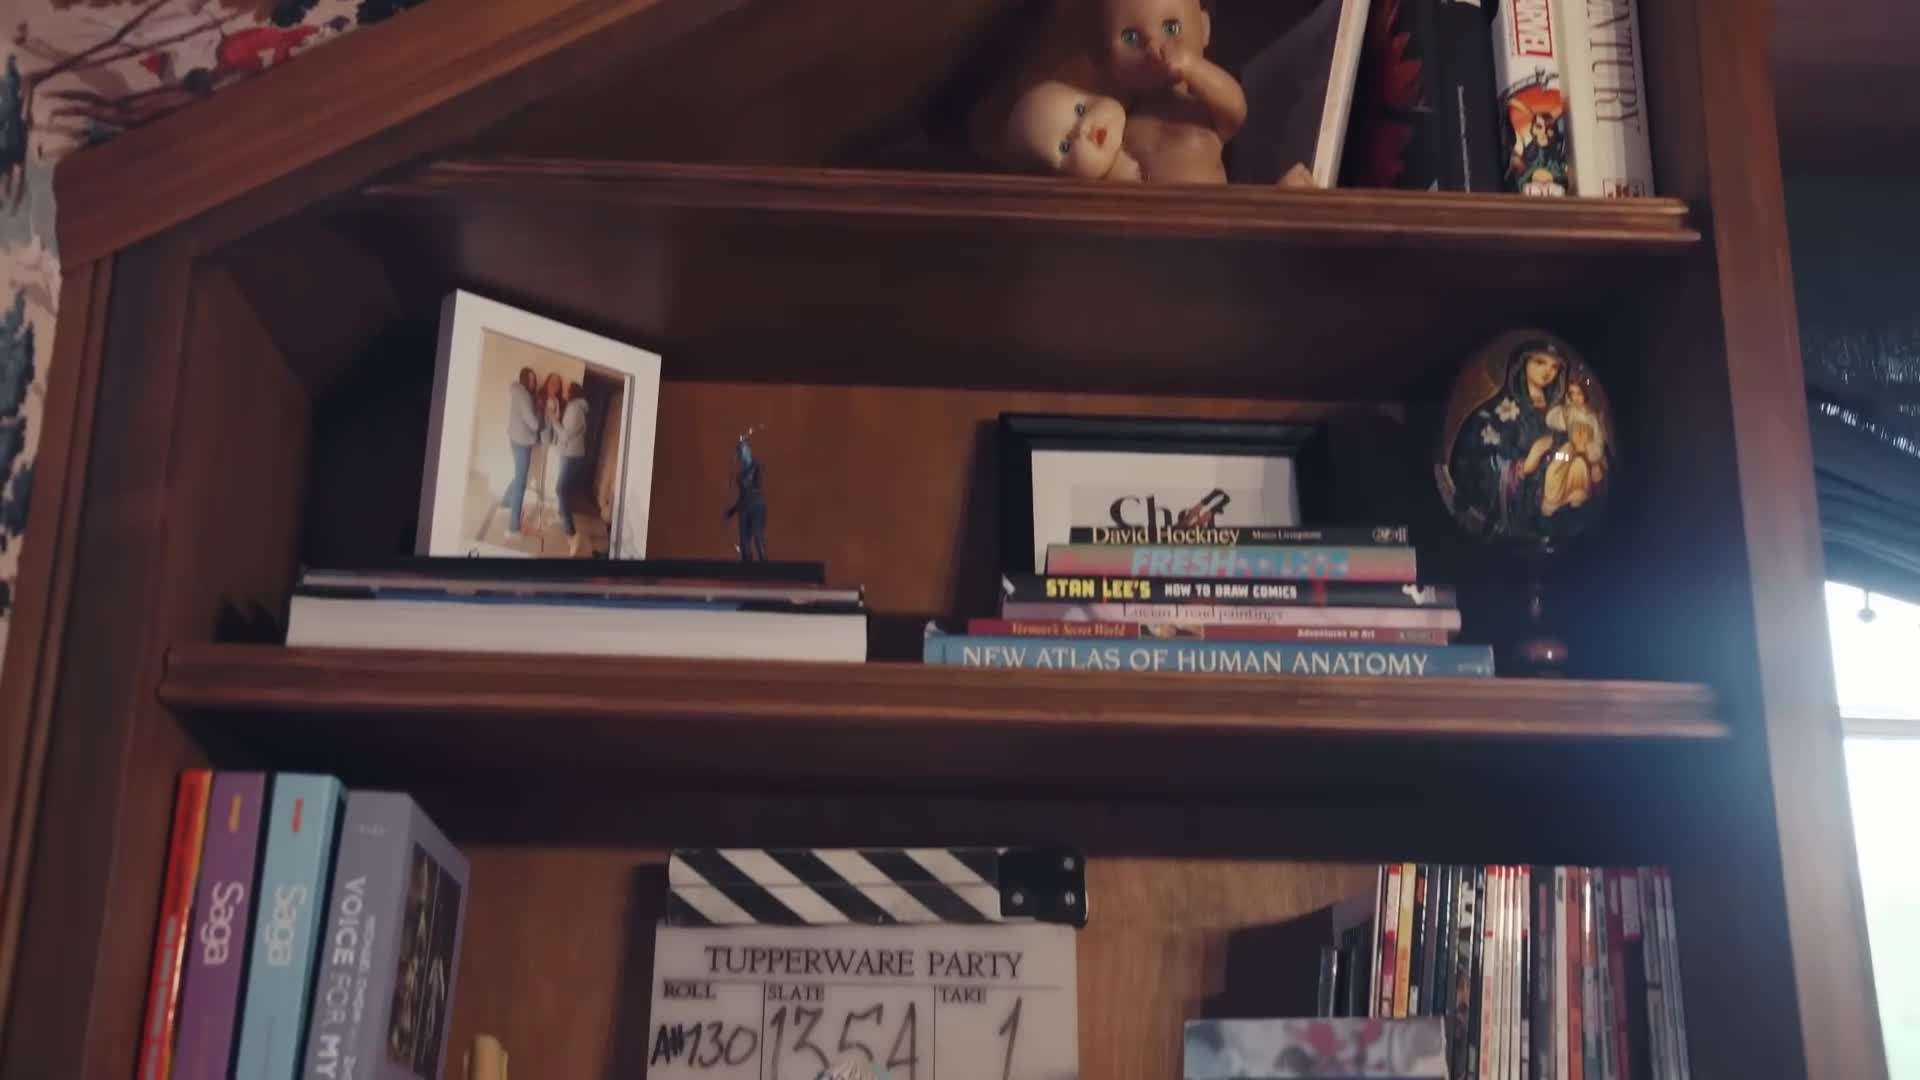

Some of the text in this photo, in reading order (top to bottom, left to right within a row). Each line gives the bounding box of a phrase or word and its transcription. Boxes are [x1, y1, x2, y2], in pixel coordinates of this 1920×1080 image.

[1092, 526, 1240, 545] David Hockney
[1130, 548, 1235, 576] FRESH
[1046, 579, 1151, 599] STAN LEE'S
[1164, 583, 1298, 599] HOW TO DRAW COMICS
[1296, 628, 1348, 640] Adventures
[1361, 629, 1376, 641] Art
[962, 645, 1027, 668] NEW
[1035, 647, 1122, 671] ATLAS
[1129, 649, 1169, 672] OF
[1177, 650, 1282, 674] HUMAN
[1292, 651, 1429, 676] ANATOMY
[200, 880, 245, 966] Saga
[264, 882, 308, 967] Saga
[332, 876, 367, 965] VOICE
[704, 945, 1024, 978] TUPPERWARE PARTY
[322, 971, 352, 1024] FOR
[663, 979, 717, 999] ROLL
[768, 983, 825, 1002] SLATE
[940, 987, 988, 1005] TAKE
[998, 996, 1023, 1080] 1
[314, 1033, 342, 1079] MY
